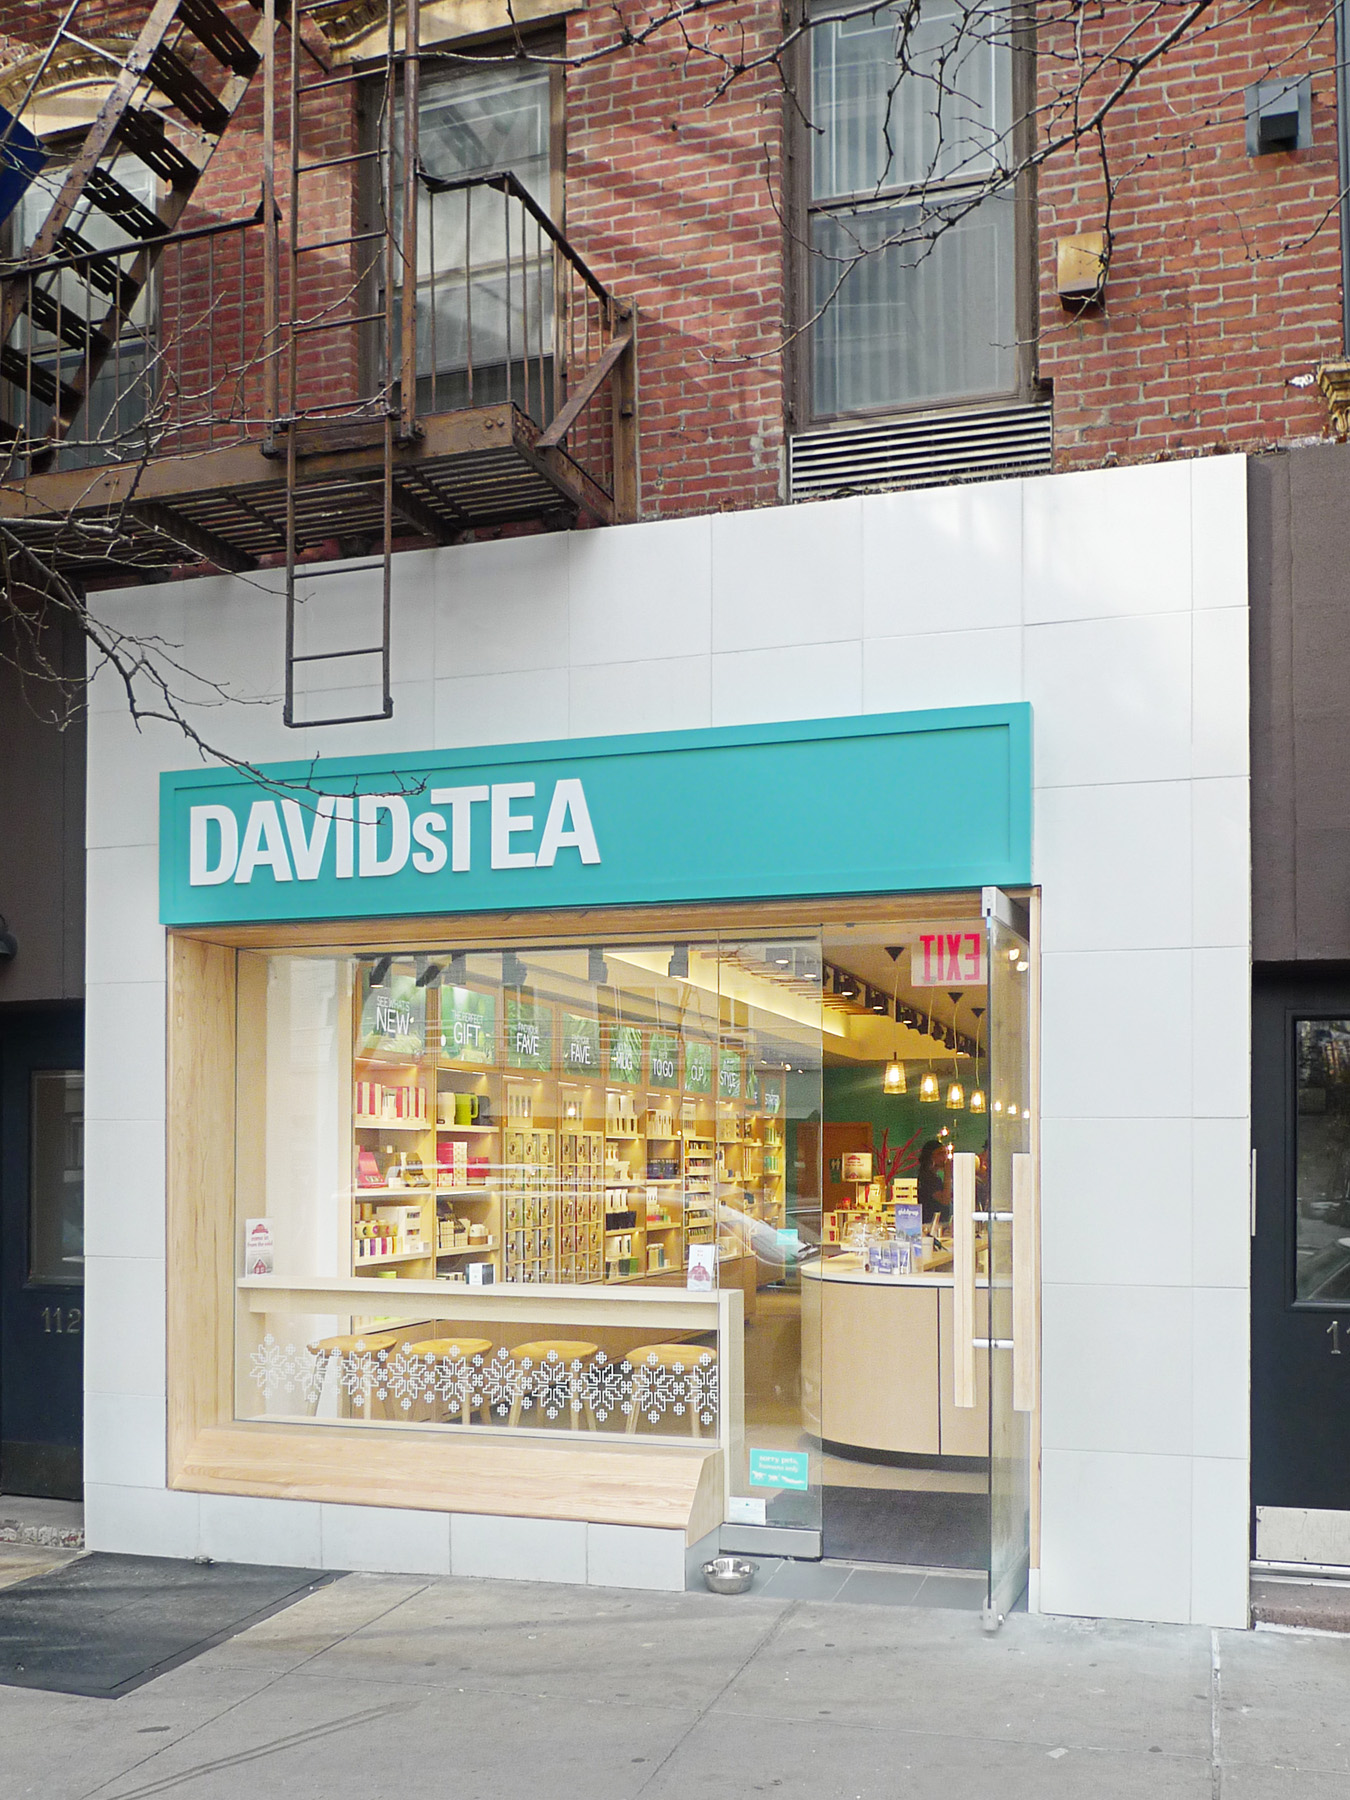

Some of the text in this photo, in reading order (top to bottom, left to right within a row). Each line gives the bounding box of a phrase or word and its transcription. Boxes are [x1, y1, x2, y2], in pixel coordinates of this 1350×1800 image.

[376, 1007, 410, 1035] NEW
[453, 1021, 481, 1047] GIFT
[516, 1032, 540, 1056] FAVE
[570, 1042, 592, 1065] FAVE
[615, 1051, 633, 1071] MUG
[652, 1057, 663, 1077] TO
[662, 1060, 674, 1079] GO
[41, 1306, 82, 1334] 112
[1326, 1320, 1350, 1354] 1
